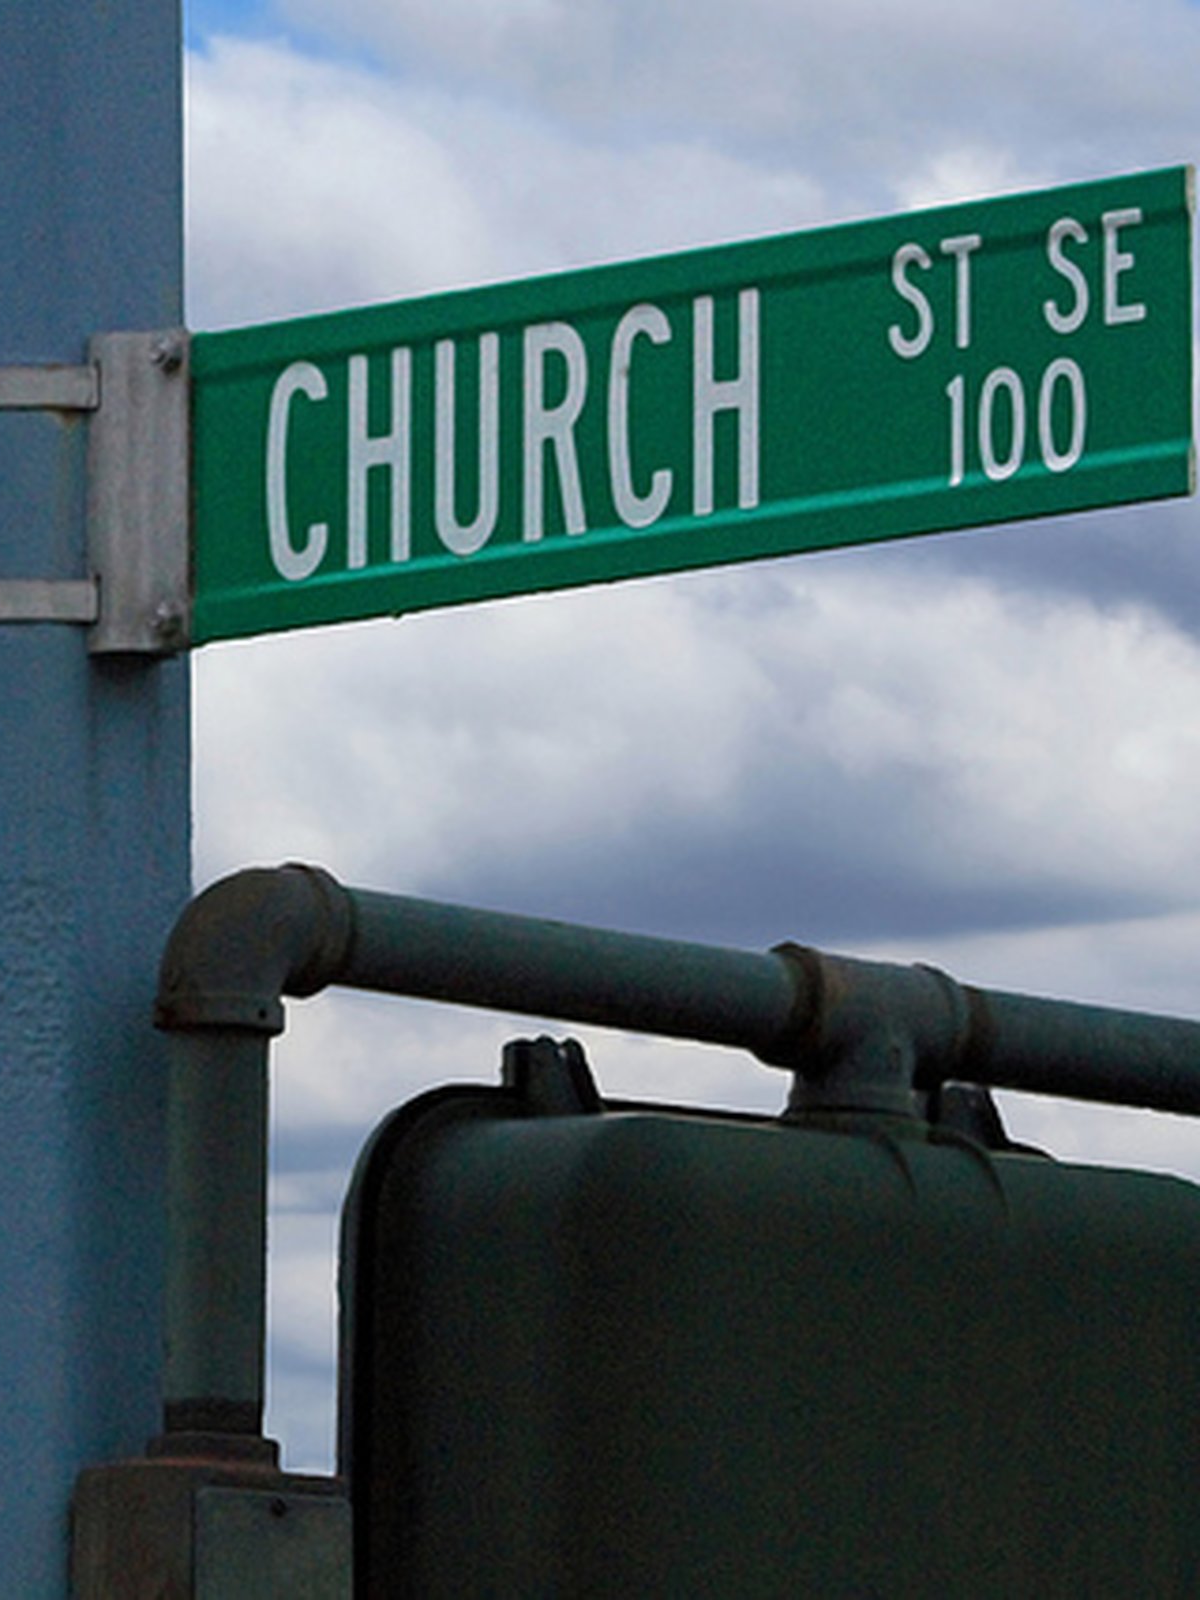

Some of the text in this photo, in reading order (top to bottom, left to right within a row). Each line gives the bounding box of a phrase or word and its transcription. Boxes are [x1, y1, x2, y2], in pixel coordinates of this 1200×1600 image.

[265, 207, 1147, 582] CHURCH ST SE
[946, 357, 1087, 487] 100
